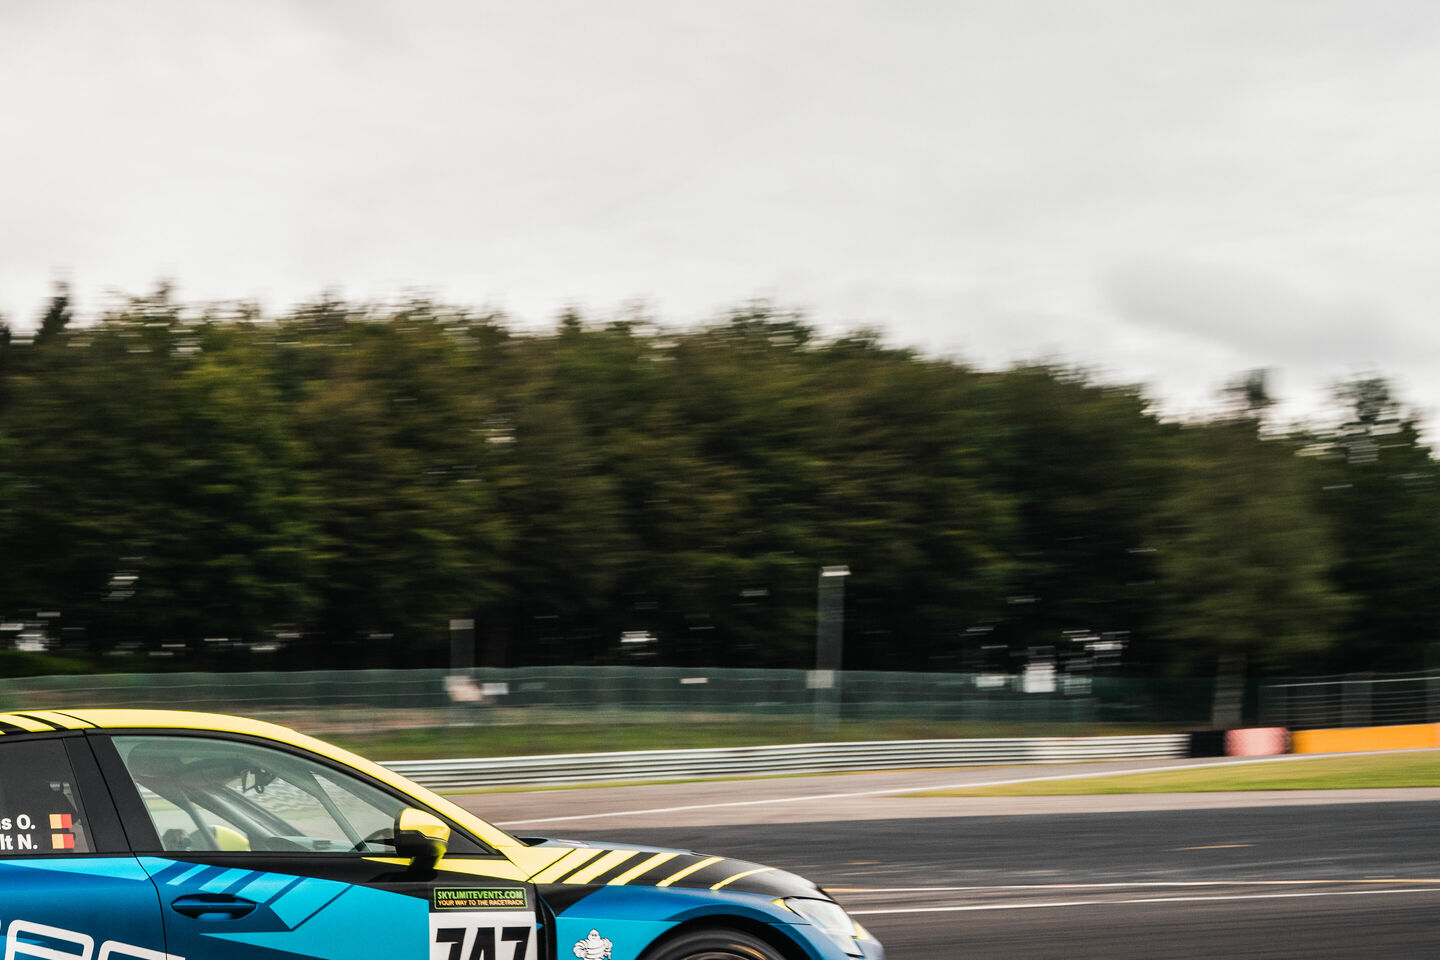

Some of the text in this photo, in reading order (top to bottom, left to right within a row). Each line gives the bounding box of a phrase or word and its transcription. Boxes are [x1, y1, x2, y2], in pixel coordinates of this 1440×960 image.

[16, 814, 36, 830] O.
[17, 834, 38, 850] N.
[437, 890, 523, 899] SKYLIMITEVENTS.COM
